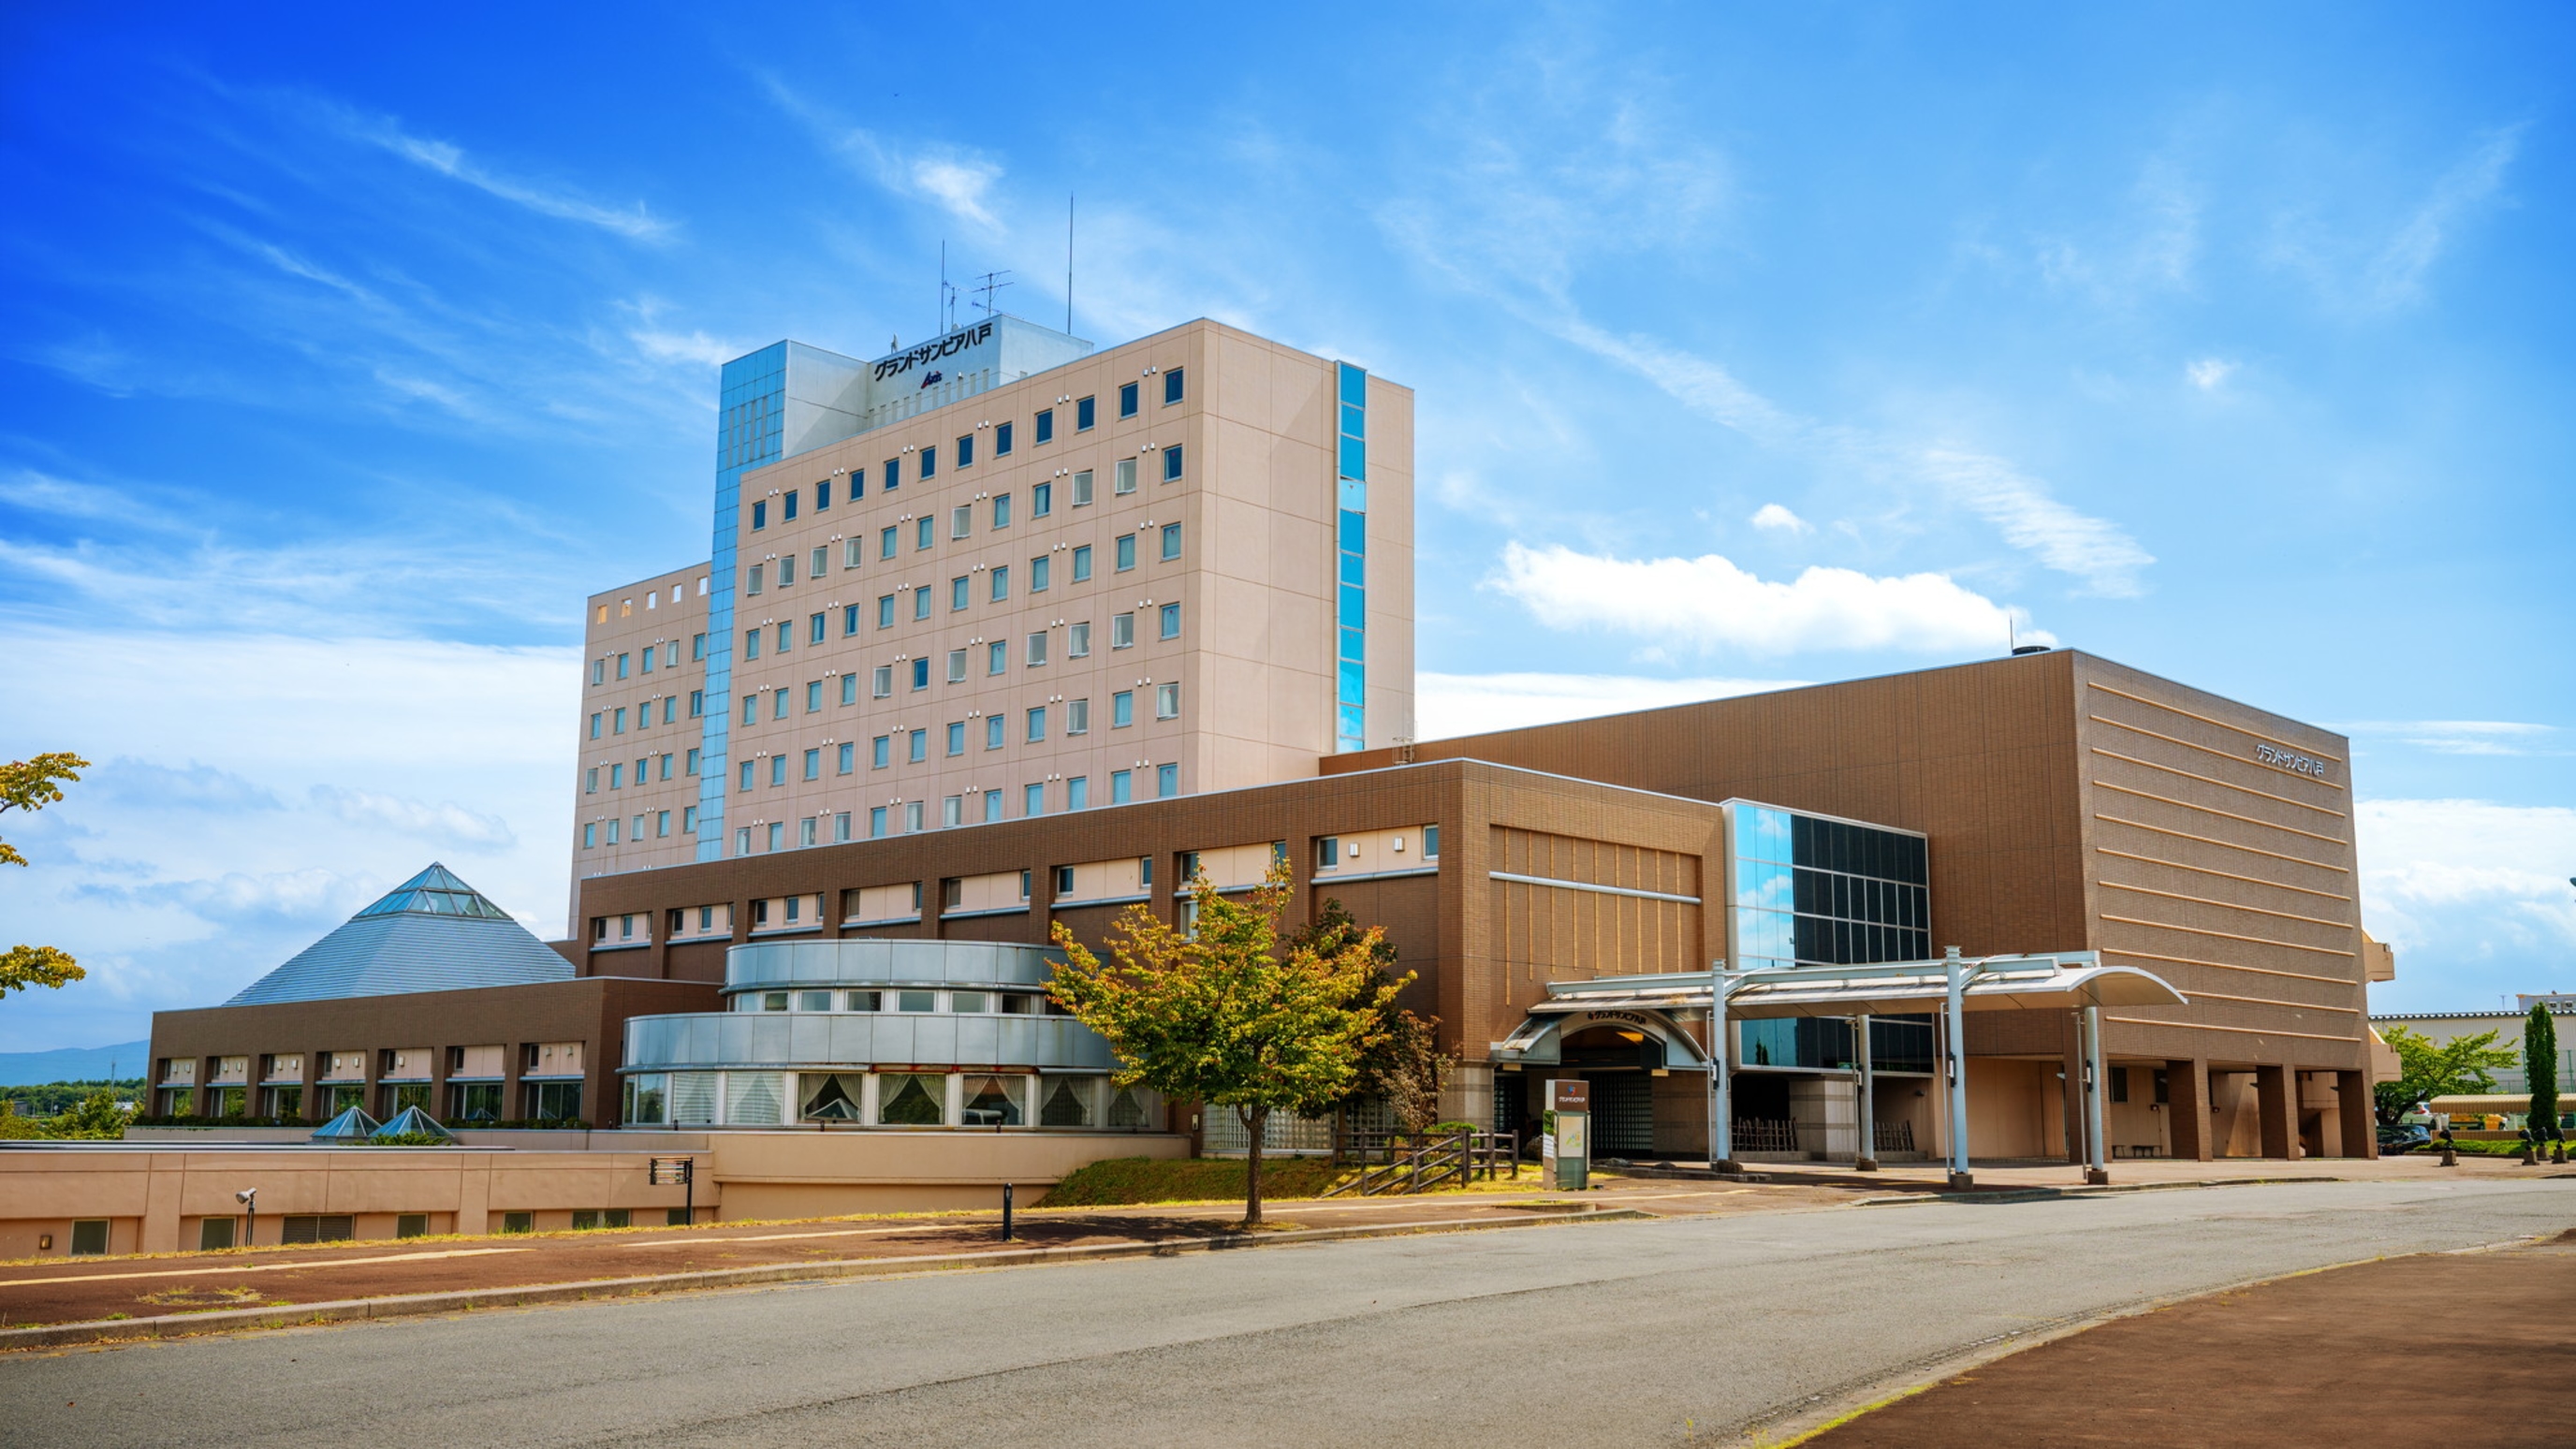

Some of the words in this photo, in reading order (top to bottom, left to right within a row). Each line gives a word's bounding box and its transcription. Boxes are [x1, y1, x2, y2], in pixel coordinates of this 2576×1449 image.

[874, 322, 992, 382] グランドサンピア八戸
[2256, 743, 2324, 777] グランドサンピア八戸
